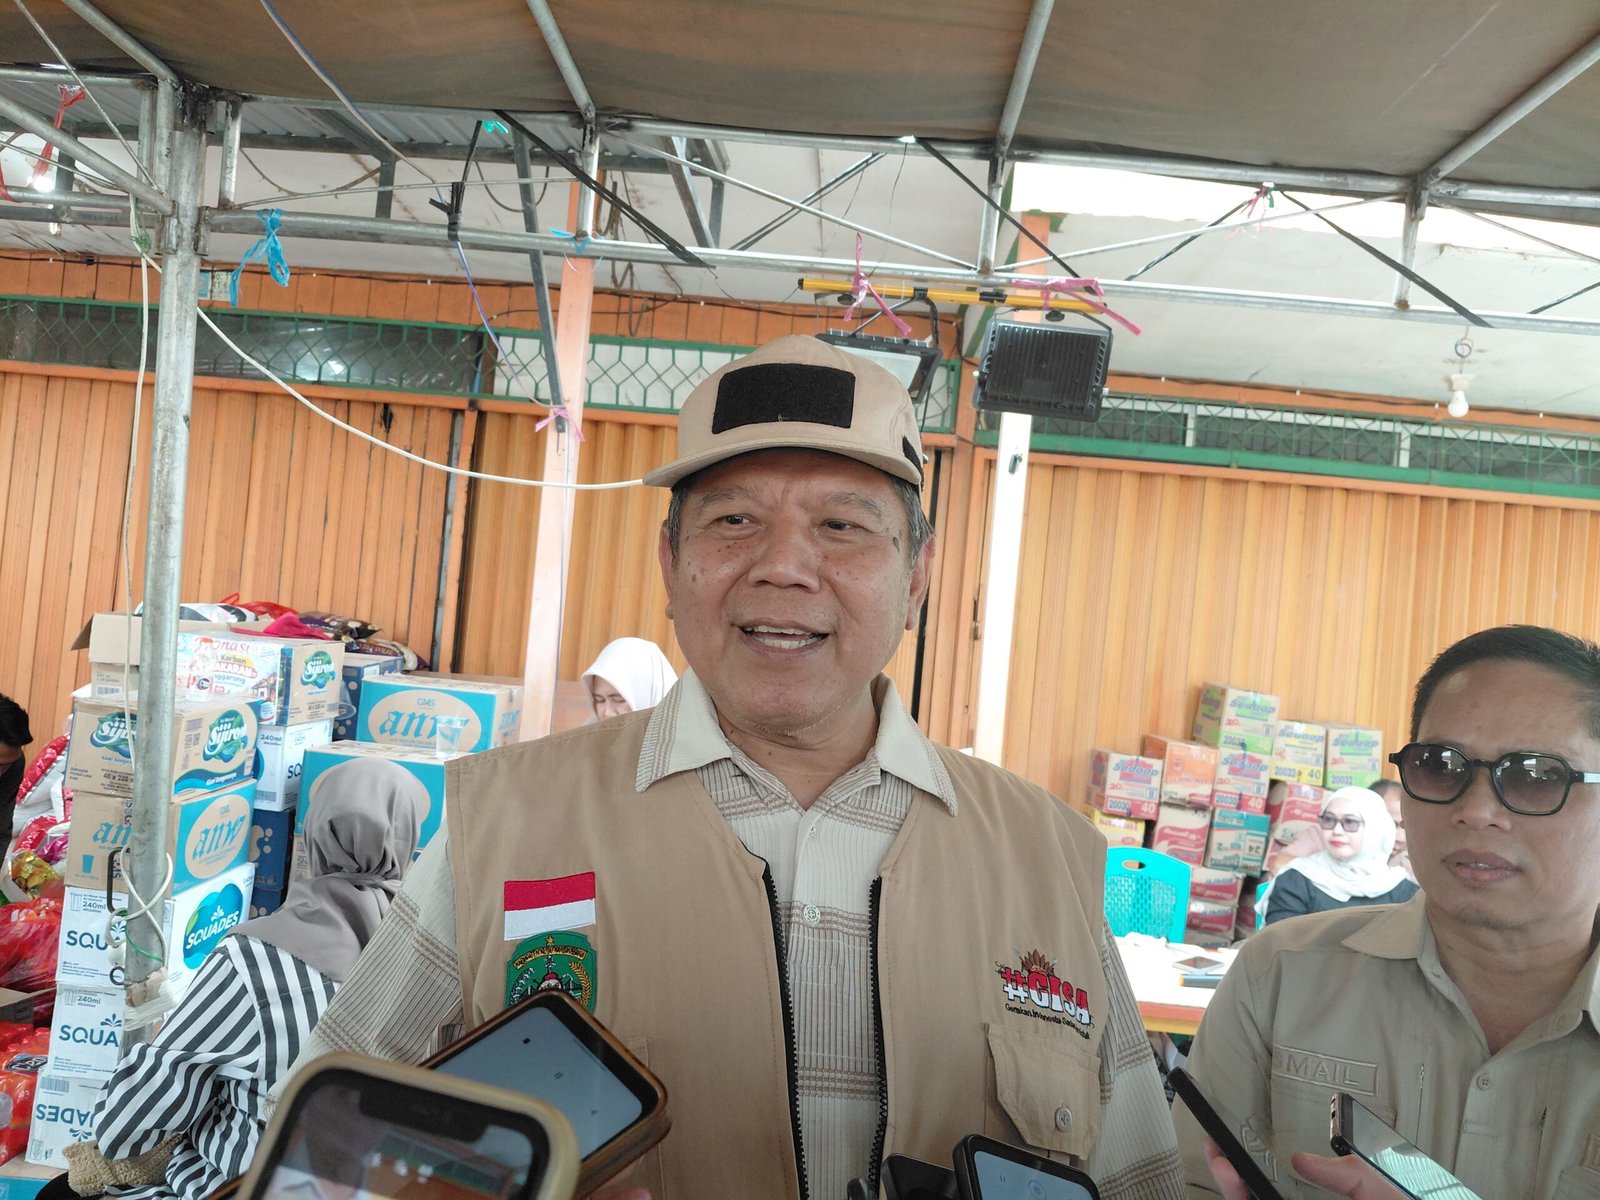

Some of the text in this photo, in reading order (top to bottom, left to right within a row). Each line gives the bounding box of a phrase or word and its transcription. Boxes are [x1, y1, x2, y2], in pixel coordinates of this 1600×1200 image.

[416, 697, 436, 707] GMS
[287, 762, 302, 779] SQ
[1308, 769, 1321, 780] 40
[1141, 802, 1155, 814] 40
[1248, 797, 1264, 808] 40
[92, 820, 133, 846] an
[82, 901, 107, 910] 240ml
[186, 911, 240, 950] SQUADES
[65, 929, 109, 951] SQU
[77, 994, 101, 1004] 240ml
[58, 1024, 120, 1048] SQUA
[1275, 1051, 1360, 1087] MAIL
